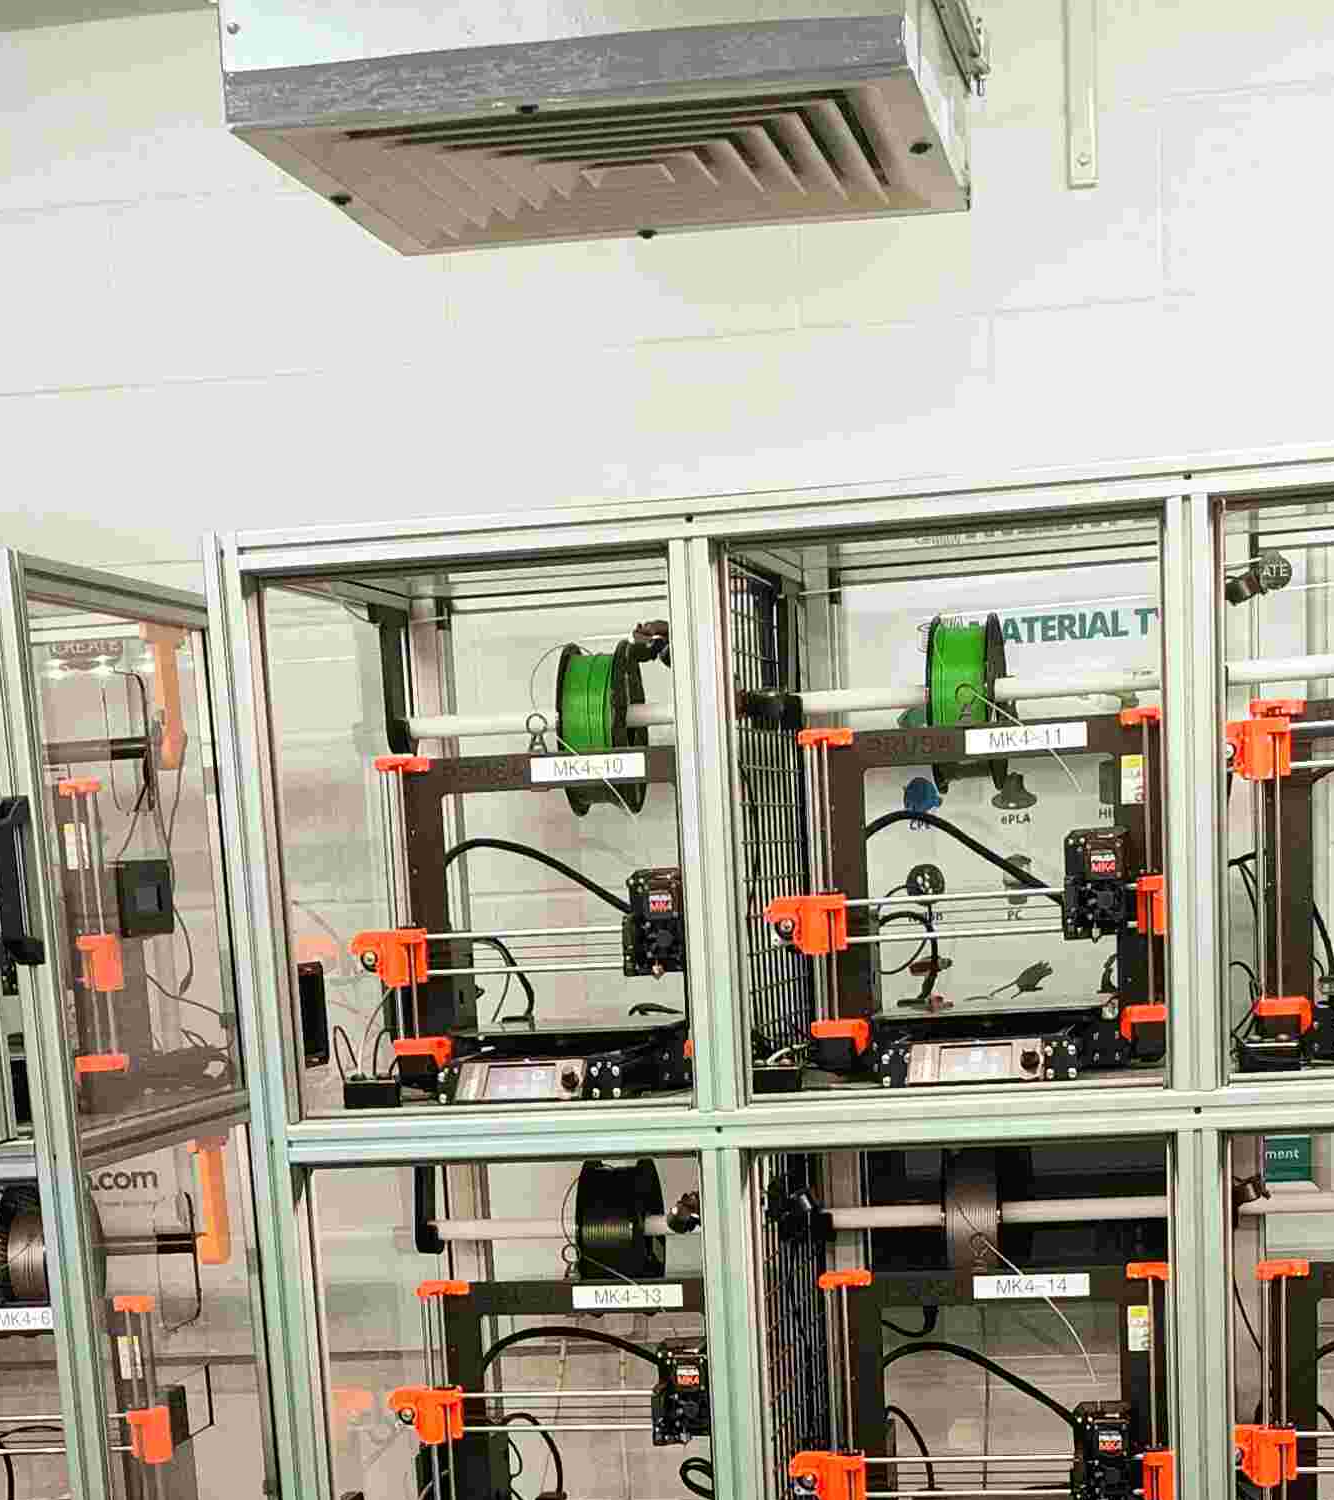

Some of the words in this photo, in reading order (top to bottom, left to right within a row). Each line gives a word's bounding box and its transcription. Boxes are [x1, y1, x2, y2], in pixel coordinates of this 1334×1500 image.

[1001, 608, 1129, 645] ATERIAL
[594, 1288, 663, 1306] MK4-13
[996, 1275, 1068, 1297] MK4-14
